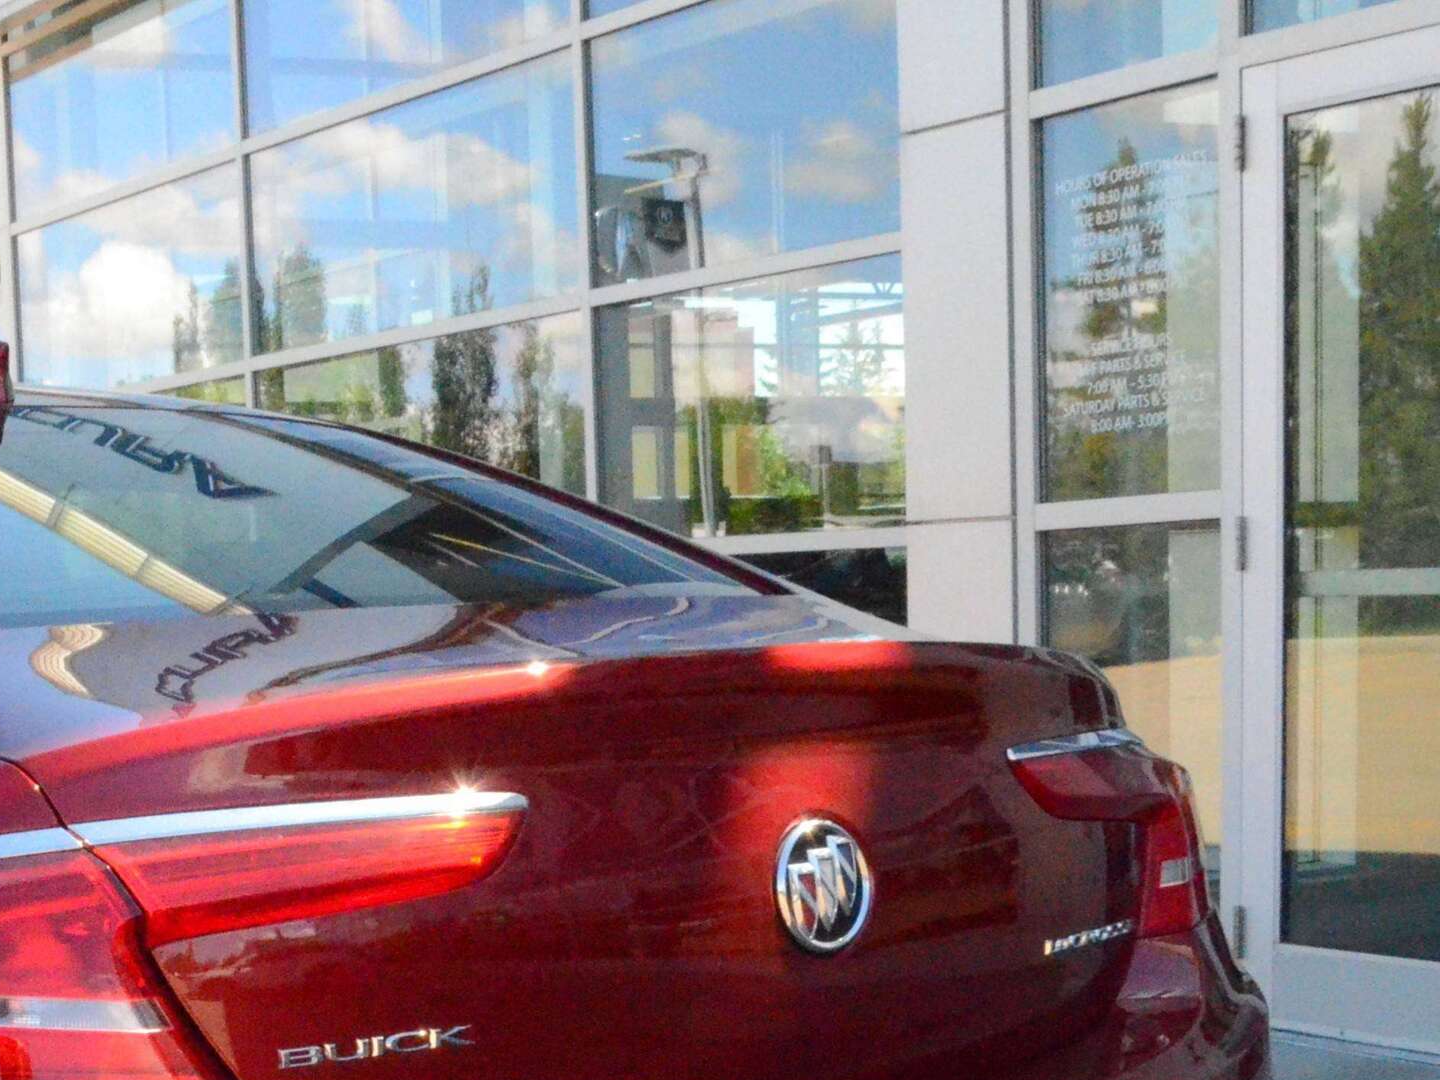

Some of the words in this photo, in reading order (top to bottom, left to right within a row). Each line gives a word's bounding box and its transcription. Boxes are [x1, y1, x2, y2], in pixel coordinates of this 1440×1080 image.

[1055, 175, 1092, 196] HOURS
[1093, 171, 1107, 188] OF
[1110, 160, 1170, 184] OPERATION
[1121, 183, 1139, 201] AM
[1095, 207, 1118, 225] 8:30
[1119, 204, 1137, 220] AM
[1063, 398, 1116, 418] SATURDAY
[1117, 392, 1149, 410] PARTS
[278, 1024, 475, 1069] BUICK
